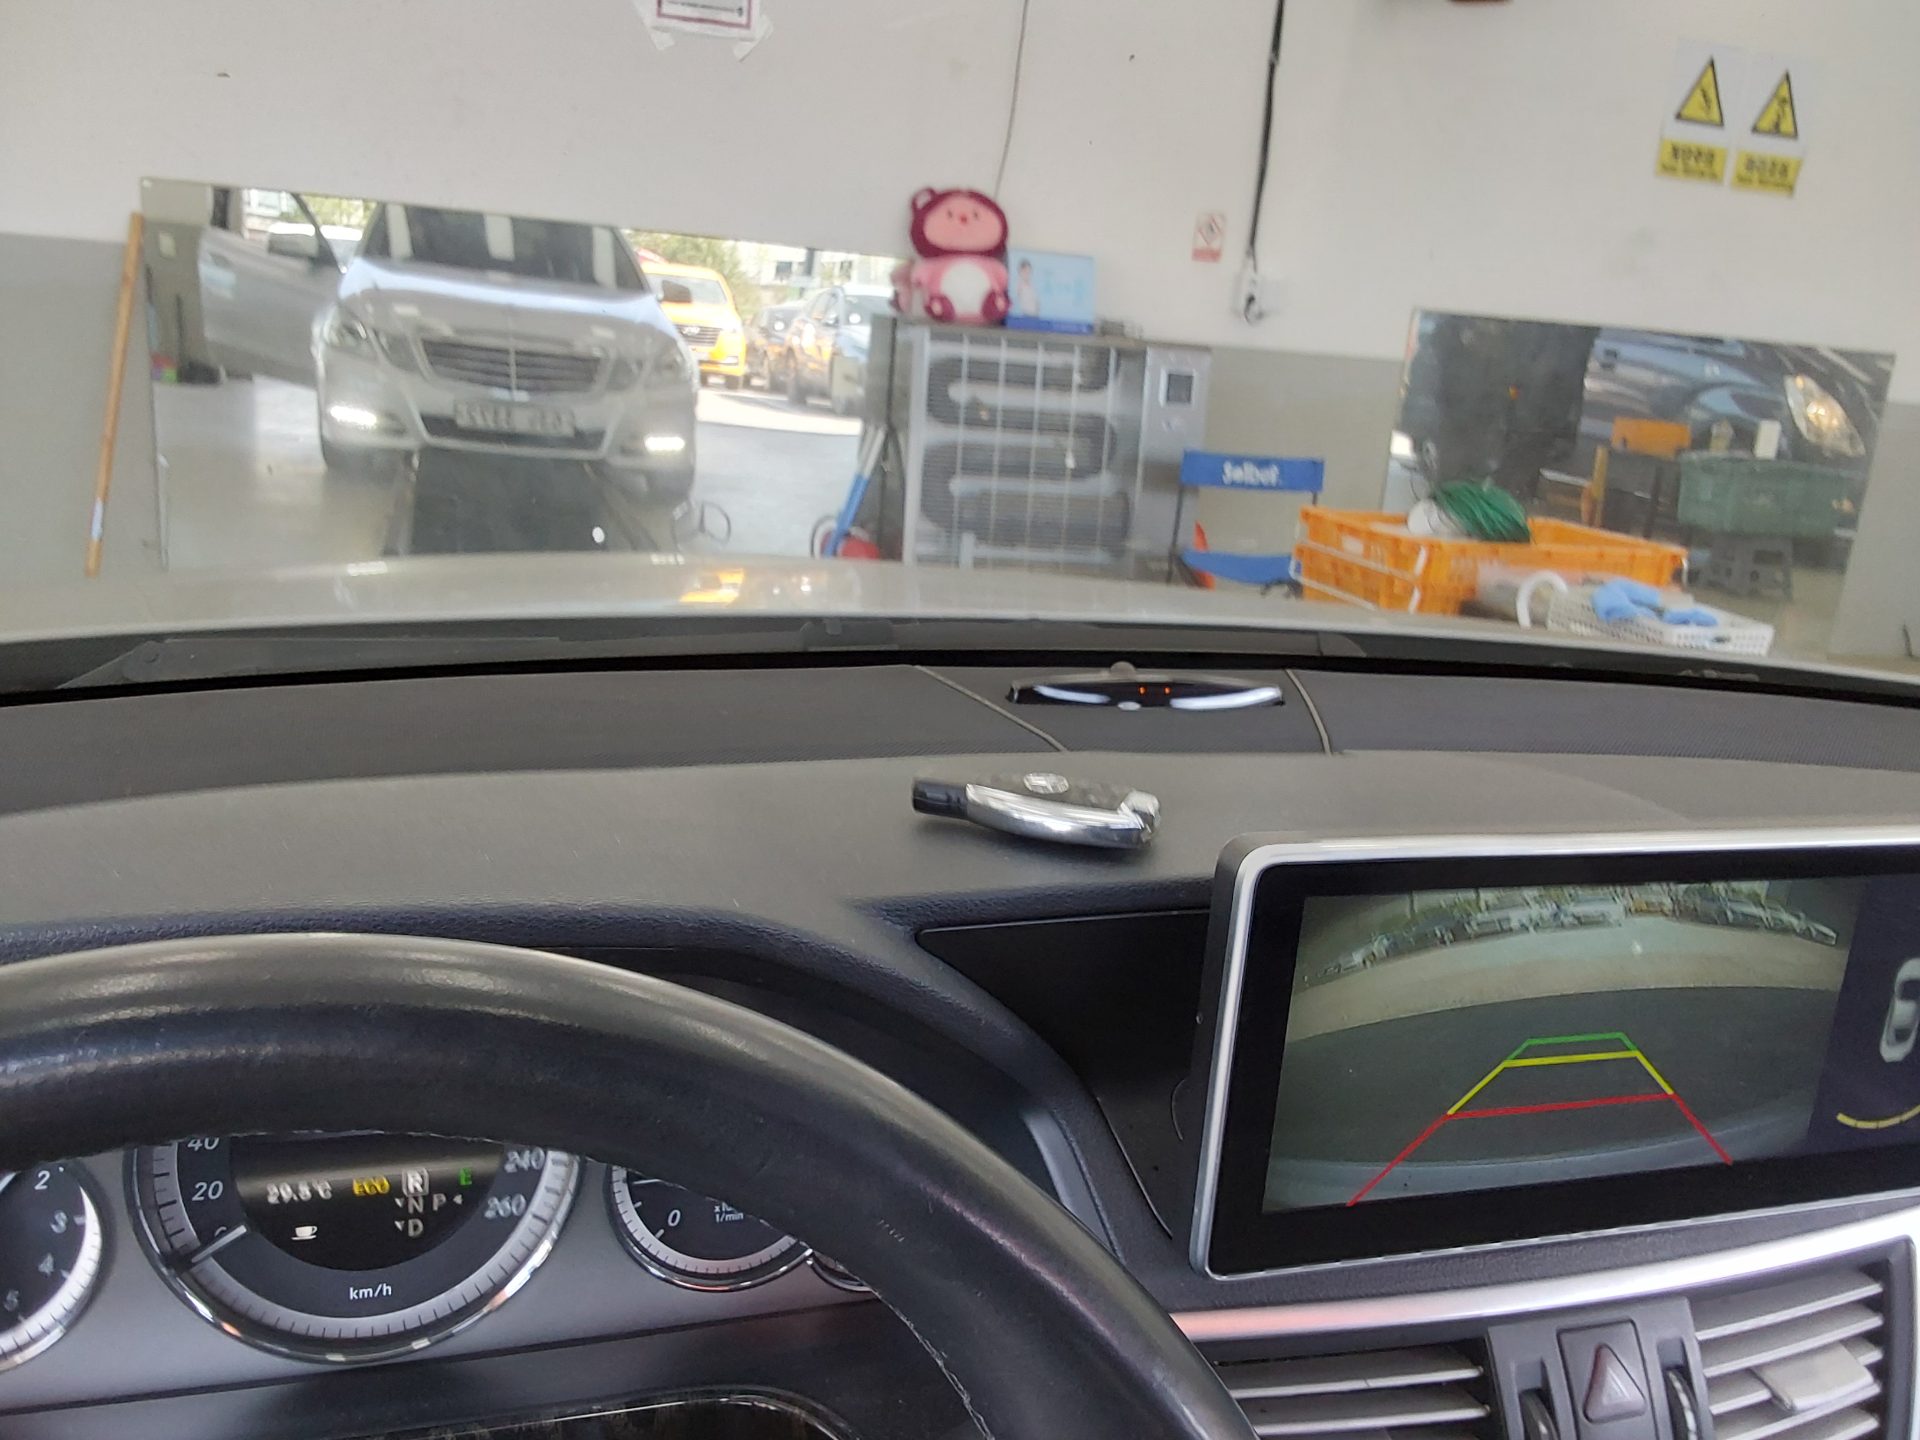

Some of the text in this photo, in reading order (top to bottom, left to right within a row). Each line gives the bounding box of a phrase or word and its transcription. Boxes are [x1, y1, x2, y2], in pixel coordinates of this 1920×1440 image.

[187, 1136, 220, 1151] 40
[506, 1148, 545, 1173] 240
[34, 1170, 50, 1191] 2
[353, 1174, 390, 1196] ECO
[406, 1170, 424, 1194] R
[459, 1167, 473, 1186] E
[191, 1180, 224, 1202] 20
[408, 1195, 424, 1214] N
[432, 1193, 447, 1211] P
[485, 1194, 526, 1219] 260
[407, 1218, 424, 1238] D
[667, 1209, 682, 1227] 0
[349, 1282, 392, 1300] km/h
